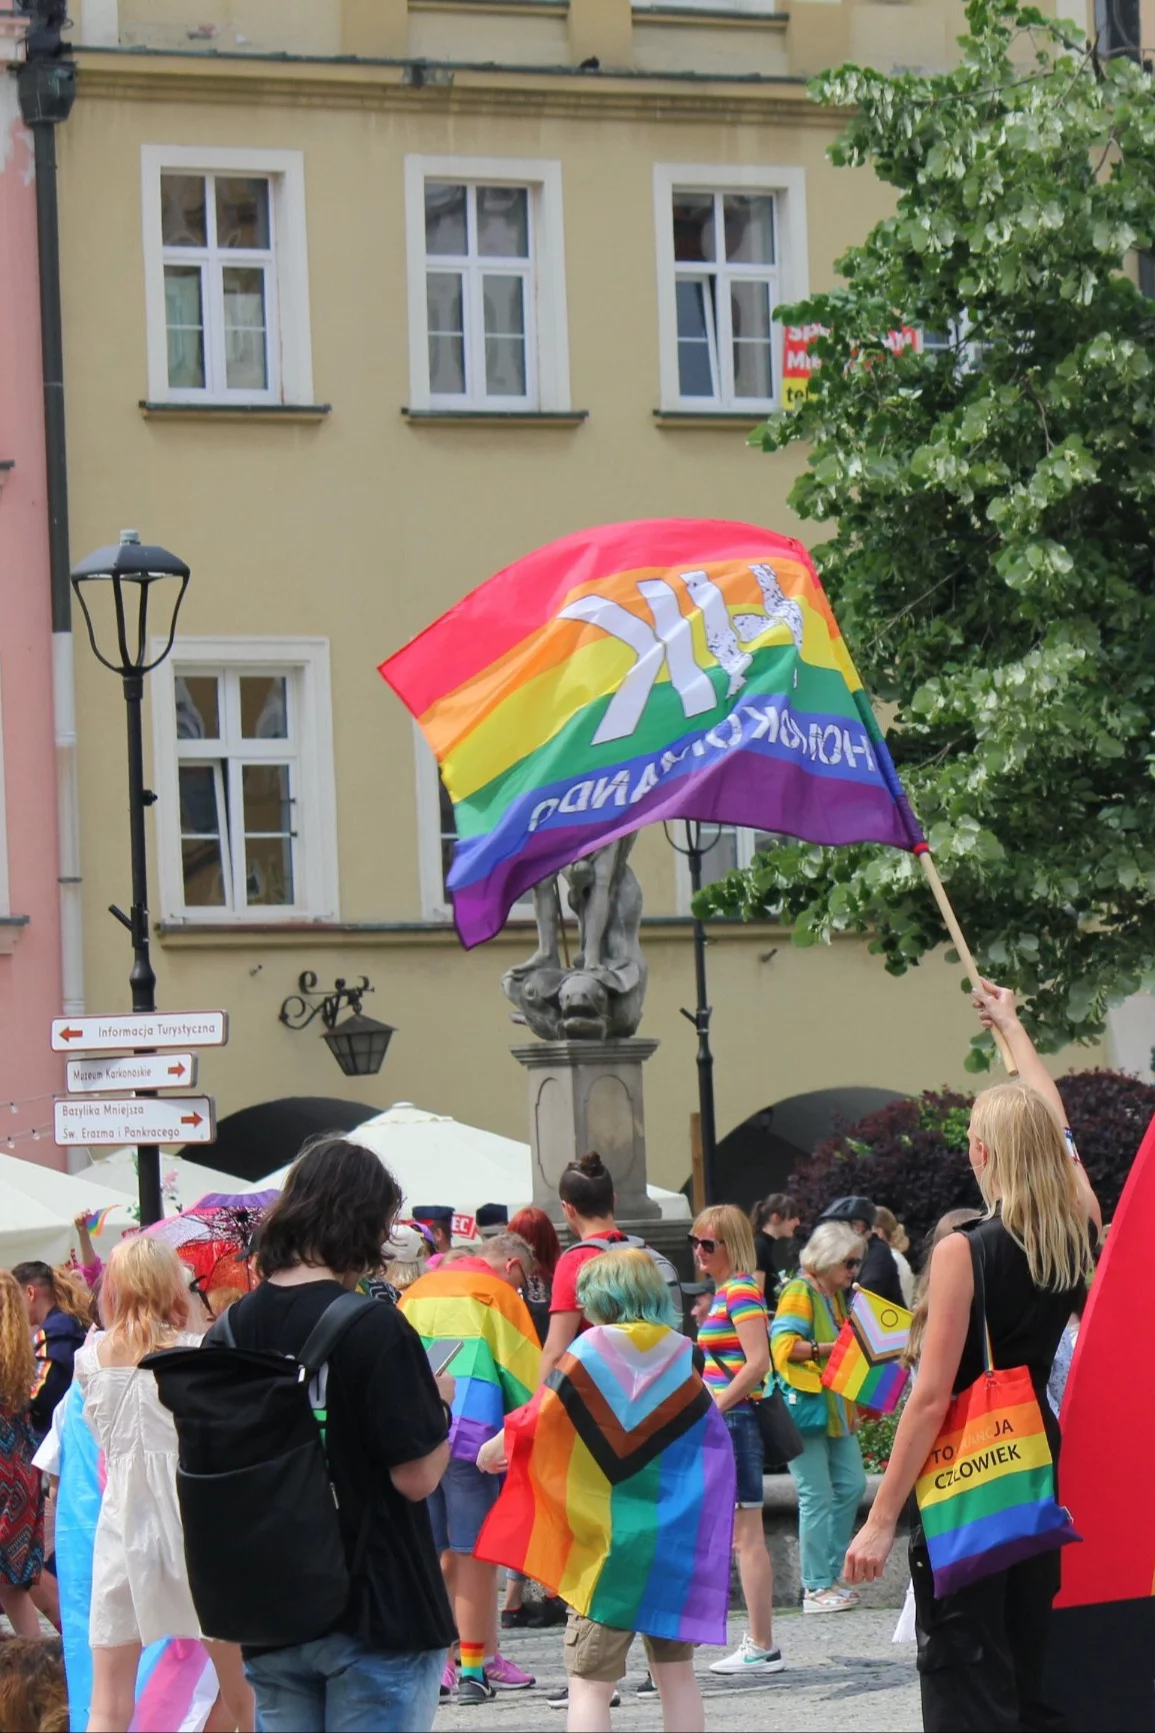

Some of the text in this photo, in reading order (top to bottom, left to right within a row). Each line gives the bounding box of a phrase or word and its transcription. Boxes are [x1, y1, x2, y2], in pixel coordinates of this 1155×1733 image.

[98, 1022, 216, 1039] Informacja Turystyczna
[73, 1065, 152, 1081] Muzeum Karkonoskie
[62, 1102, 145, 1119] Bazylika Mniejsza
[82, 1127, 115, 1139] Erazma
[125, 1126, 180, 1141] Pankracego
[934, 1443, 1022, 1490] CZŁOWIEK
